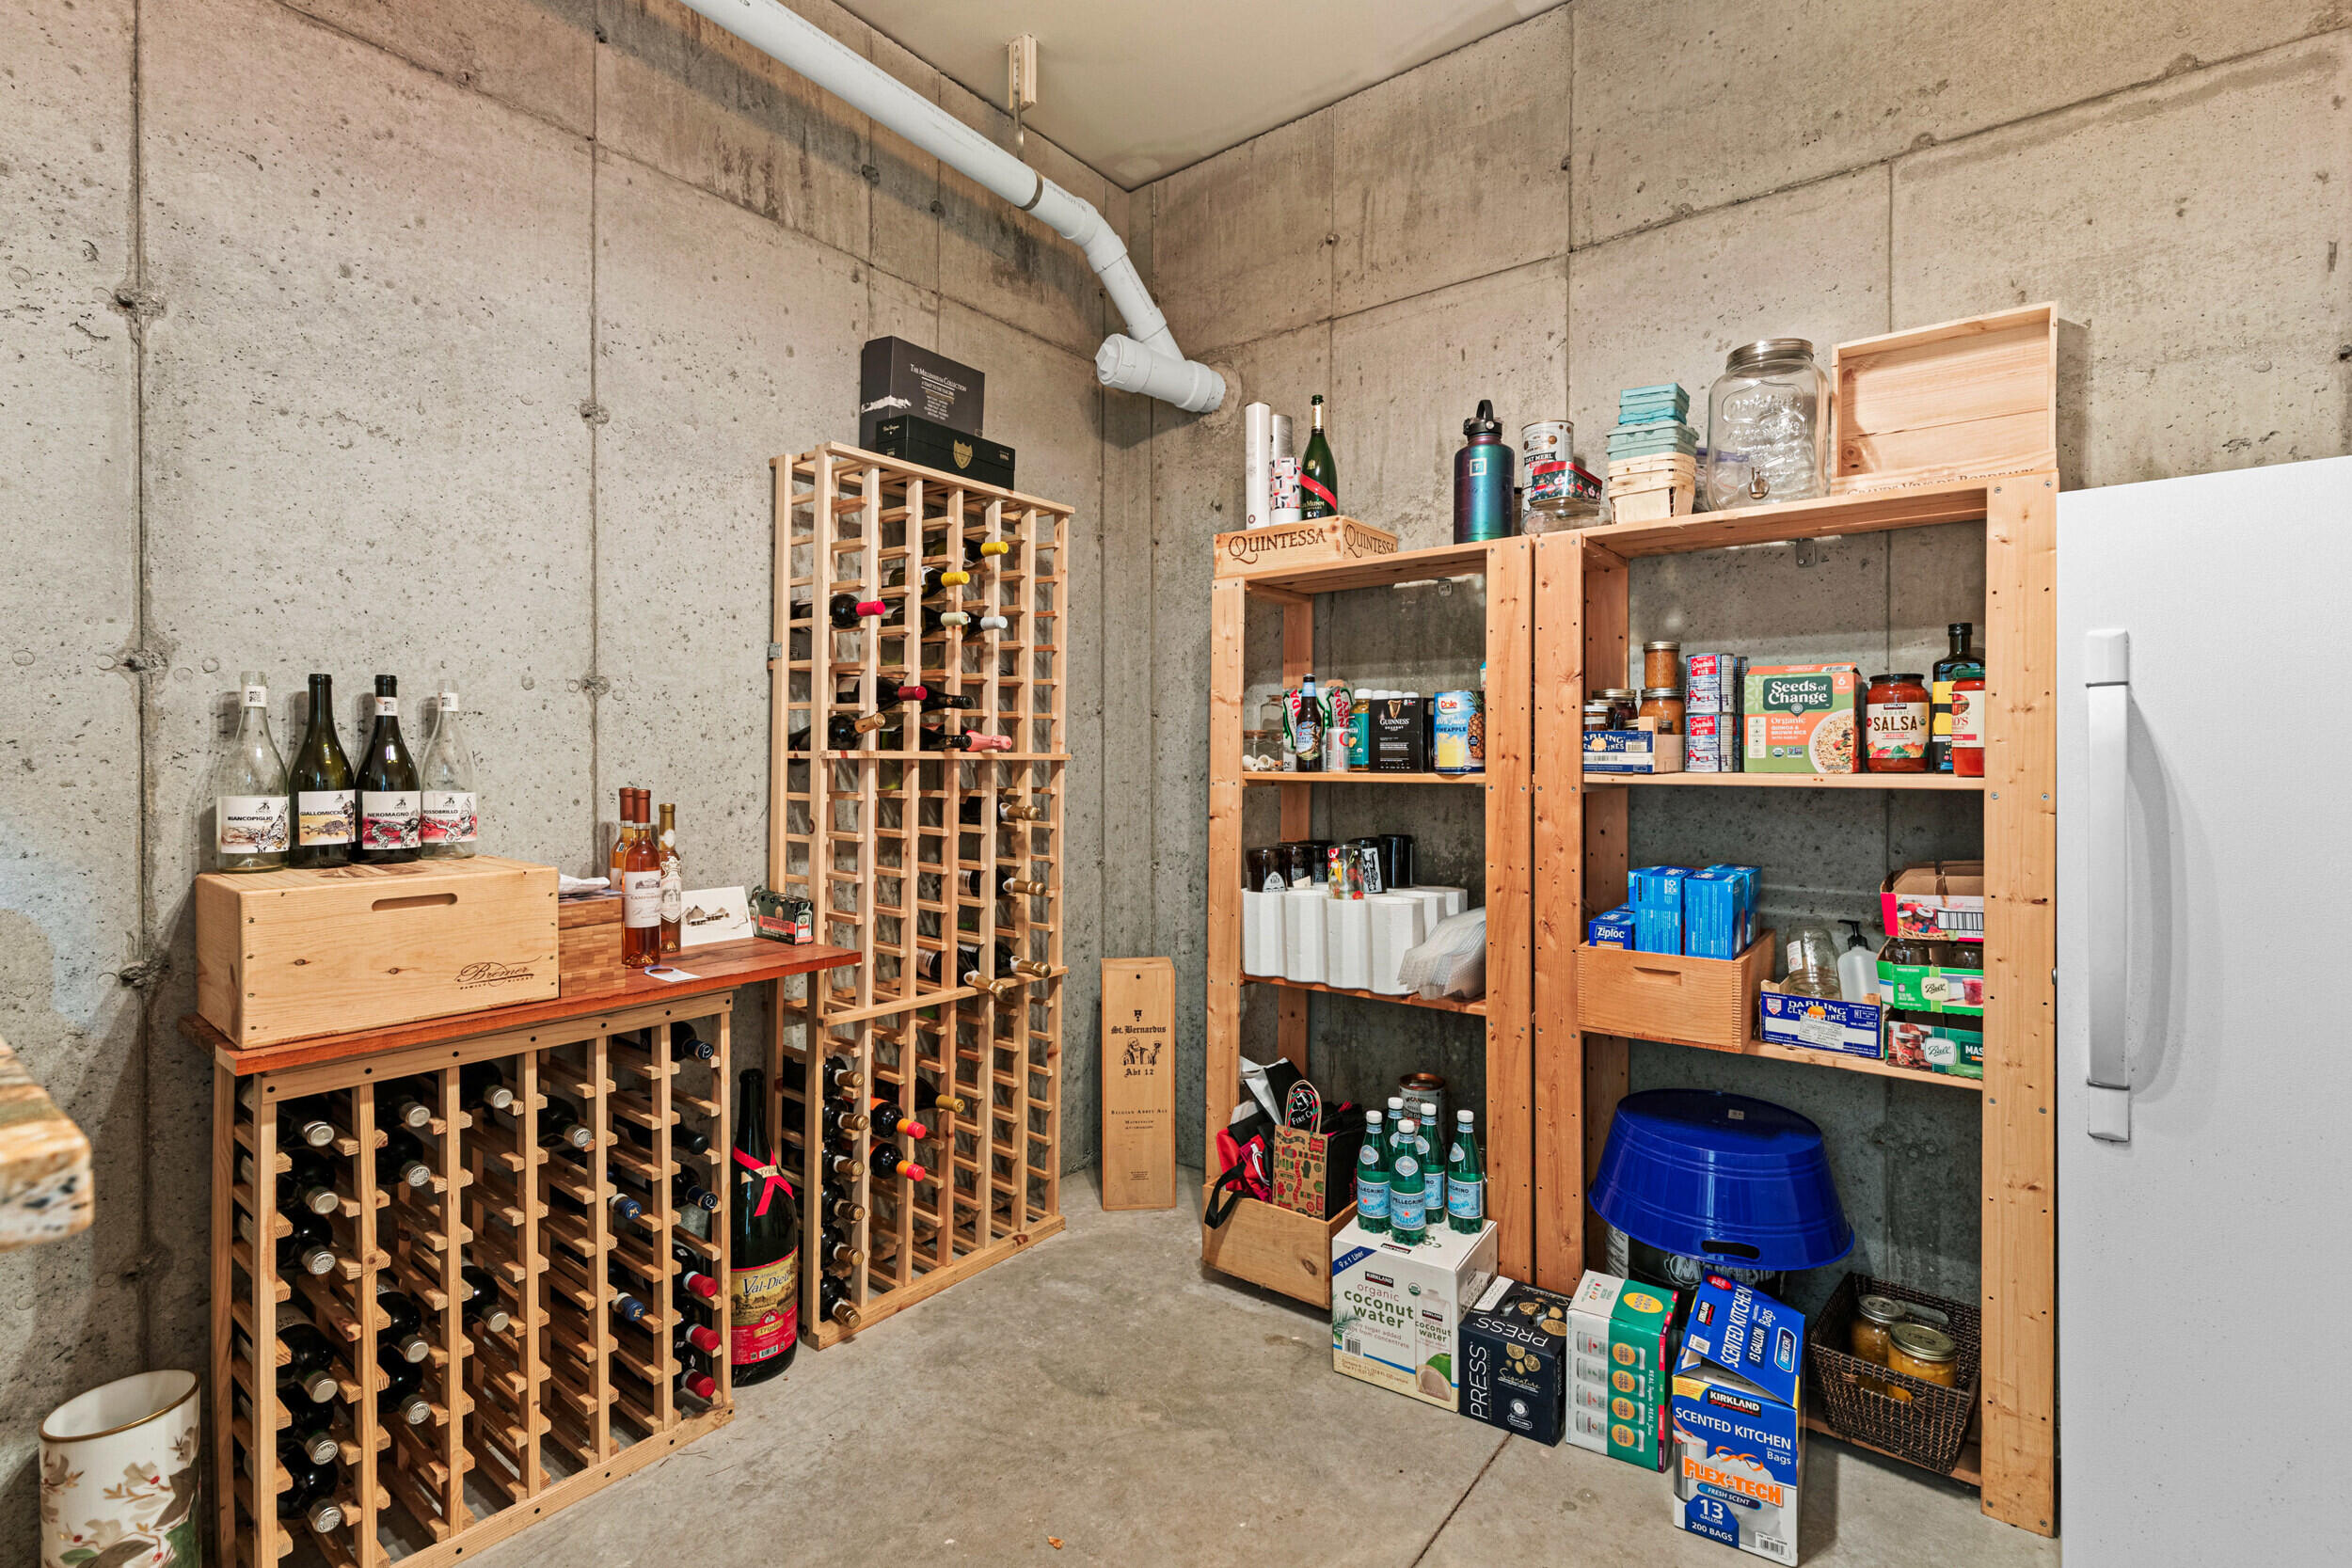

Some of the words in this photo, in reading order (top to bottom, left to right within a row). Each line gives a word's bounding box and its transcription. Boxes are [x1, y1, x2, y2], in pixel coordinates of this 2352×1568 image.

[1228, 527, 1327, 564] QUINTESSA
[1343, 524, 1395, 558] QUINTESSA
[1771, 680, 1817, 693] Seeds
[1837, 676, 1846, 686] 6
[1440, 700, 1457, 708] Dole
[1768, 691, 1828, 705] Change
[1873, 715, 1917, 731] SALSA
[1583, 733, 1624, 743] ARLING
[1597, 926, 1626, 939] Ziploc
[1925, 982, 1947, 995] Ball
[1788, 1000, 1847, 1015] DARLING
[1124, 1025, 1167, 1034] Bernardus
[1928, 1043, 1951, 1057] Ball
[1964, 1045, 1983, 1056] MAS
[1124, 1068, 1140, 1078] Abt
[1348, 1256, 1353, 1264] 1
[1352, 1250, 1364, 1260] Liter
[742, 1271, 792, 1295] Val-Dieu
[1366, 1272, 1393, 1285] KIRKLAND
[1357, 1283, 1400, 1302] organic
[1343, 1290, 1414, 1320] coconut
[1697, 1301, 1710, 1323] KIRKLAND
[1728, 1285, 1754, 1328] KITCHEN
[1353, 1306, 1405, 1328] water
[1757, 1308, 1776, 1328] Bags
[1364, 1324, 1381, 1336] sugar
[1382, 1329, 1402, 1340] added
[1415, 1321, 1452, 1337] coconut
[1419, 1328, 1447, 1342] water
[1475, 1317, 1549, 1347] PRESS
[1375, 1334, 1410, 1350] concentrate
[1720, 1324, 1745, 1369] SCENTED
[1750, 1326, 1766, 1355] GALLON
[1749, 1353, 1761, 1363] 13
[1469, 1344, 1488, 1419] PRESS
[1498, 1367, 1542, 1389] Signature
[1709, 1391, 1760, 1412] KIRKLAND
[1675, 1407, 1731, 1433] SCENTED
[1734, 1424, 1791, 1449] KITCHEN
[1767, 1451, 1791, 1465] Bags
[1682, 1455, 1784, 1507] FLEX-TECH
[1708, 1487, 1727, 1498] FRESH
[1728, 1494, 1751, 1505] SCENT
[1699, 1499, 1724, 1520] 13
[1699, 1513, 1724, 1526] GALLON
[1692, 1521, 1708, 1533] 200
[1709, 1528, 1733, 1542] BAGS
